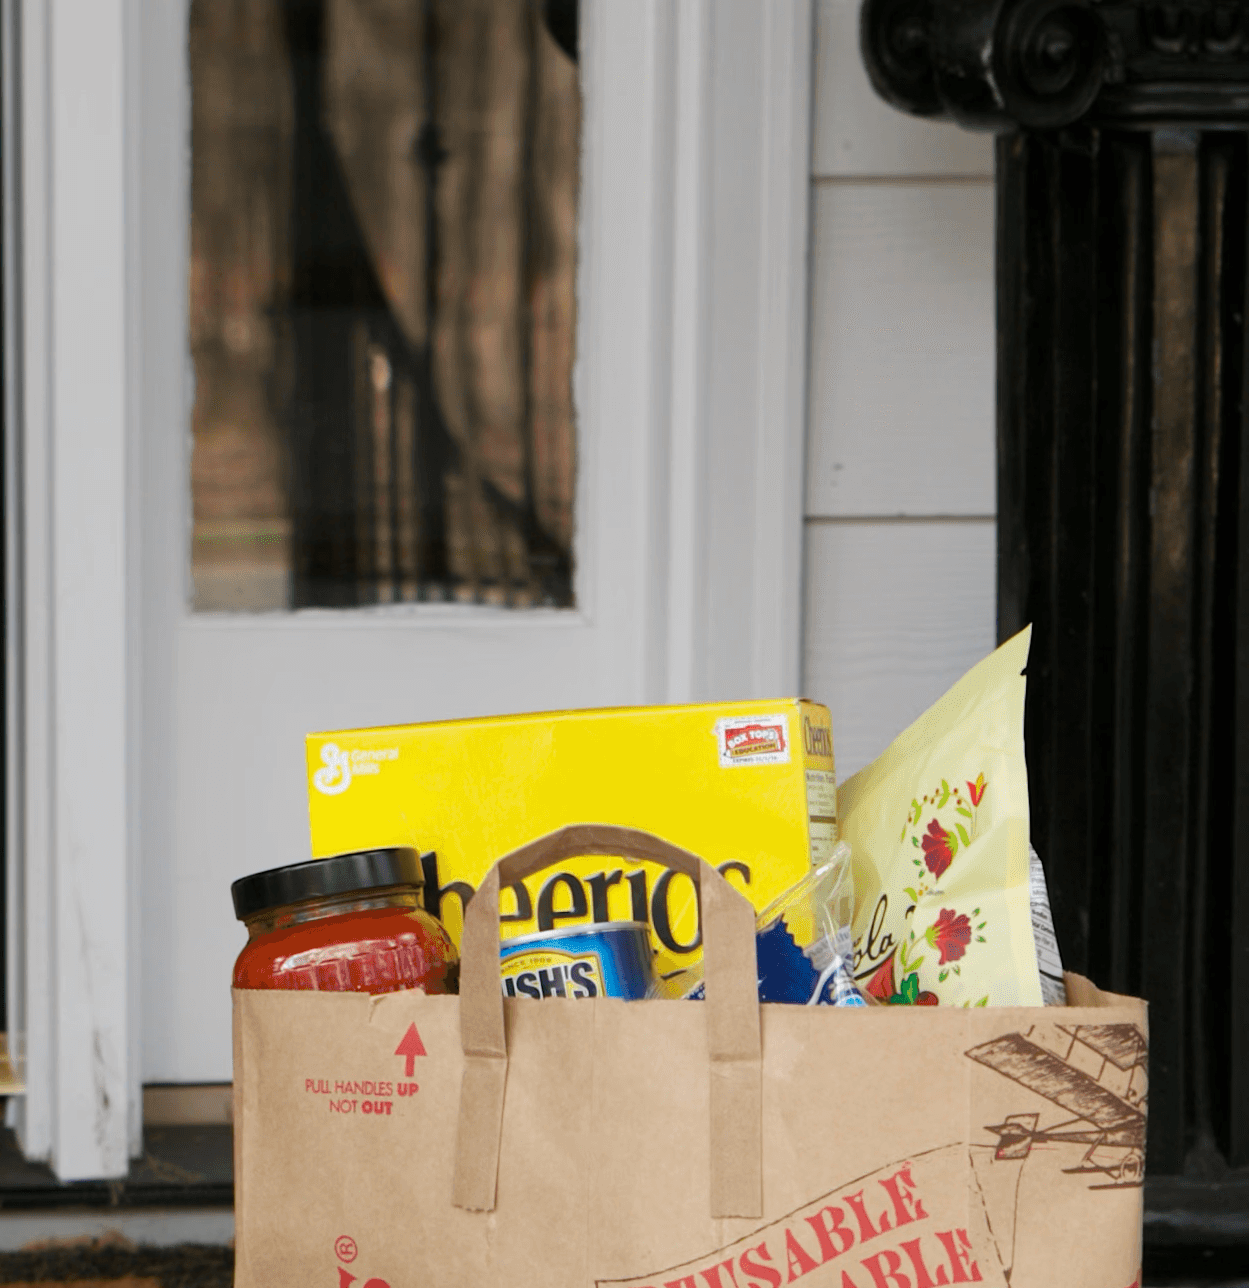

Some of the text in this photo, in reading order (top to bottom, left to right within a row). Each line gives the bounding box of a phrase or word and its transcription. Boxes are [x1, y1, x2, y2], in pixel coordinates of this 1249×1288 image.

[418, 850, 751, 954] heerio
[305, 1078, 419, 1097] PULL HANDLES UP
[329, 1099, 393, 1115] NOT OUT
